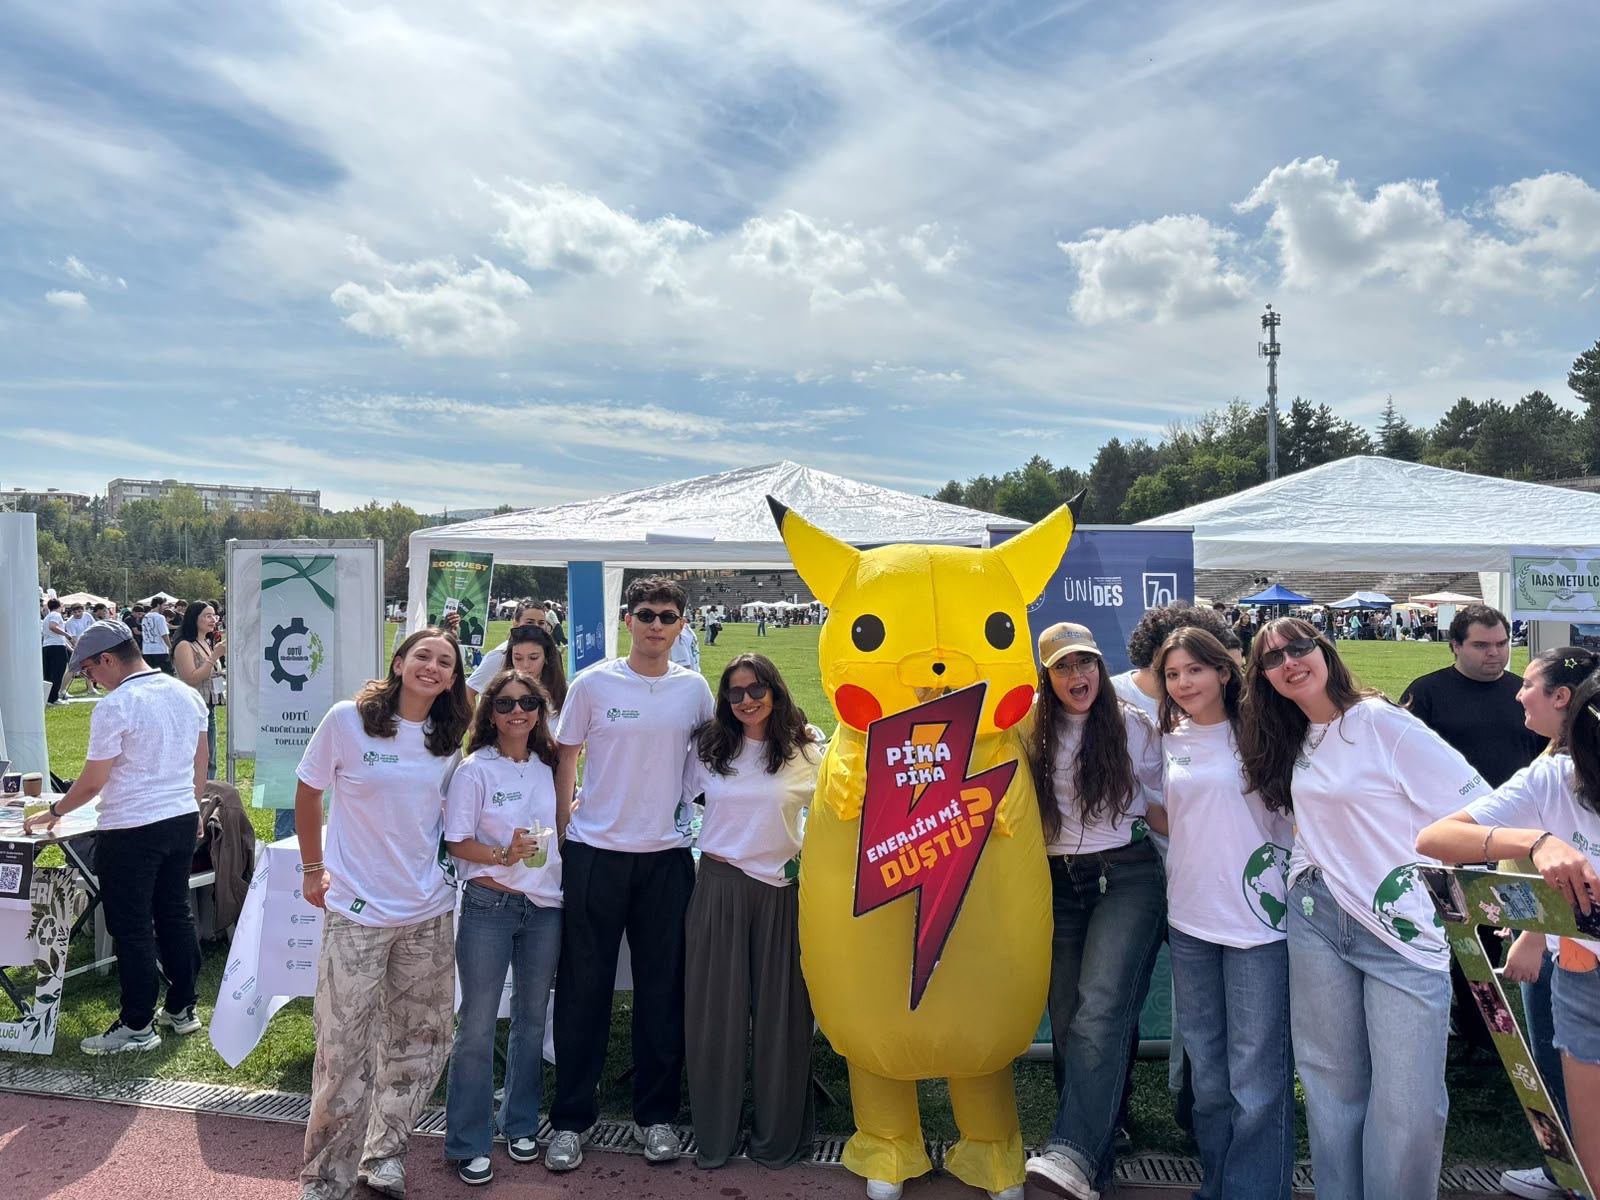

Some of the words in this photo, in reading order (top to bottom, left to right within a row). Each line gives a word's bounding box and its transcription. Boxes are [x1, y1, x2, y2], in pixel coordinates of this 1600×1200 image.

[431, 561, 489, 571] ECOQUEST
[1531, 574, 1554, 586] IAAS
[1556, 575, 1584, 587] METU
[282, 710, 310, 721] ODTÜ
[886, 740, 951, 766] PİKA
[895, 766, 946, 787] PİKA
[866, 815, 938, 863] ENERJİN
[938, 799, 962, 824] Mİ
